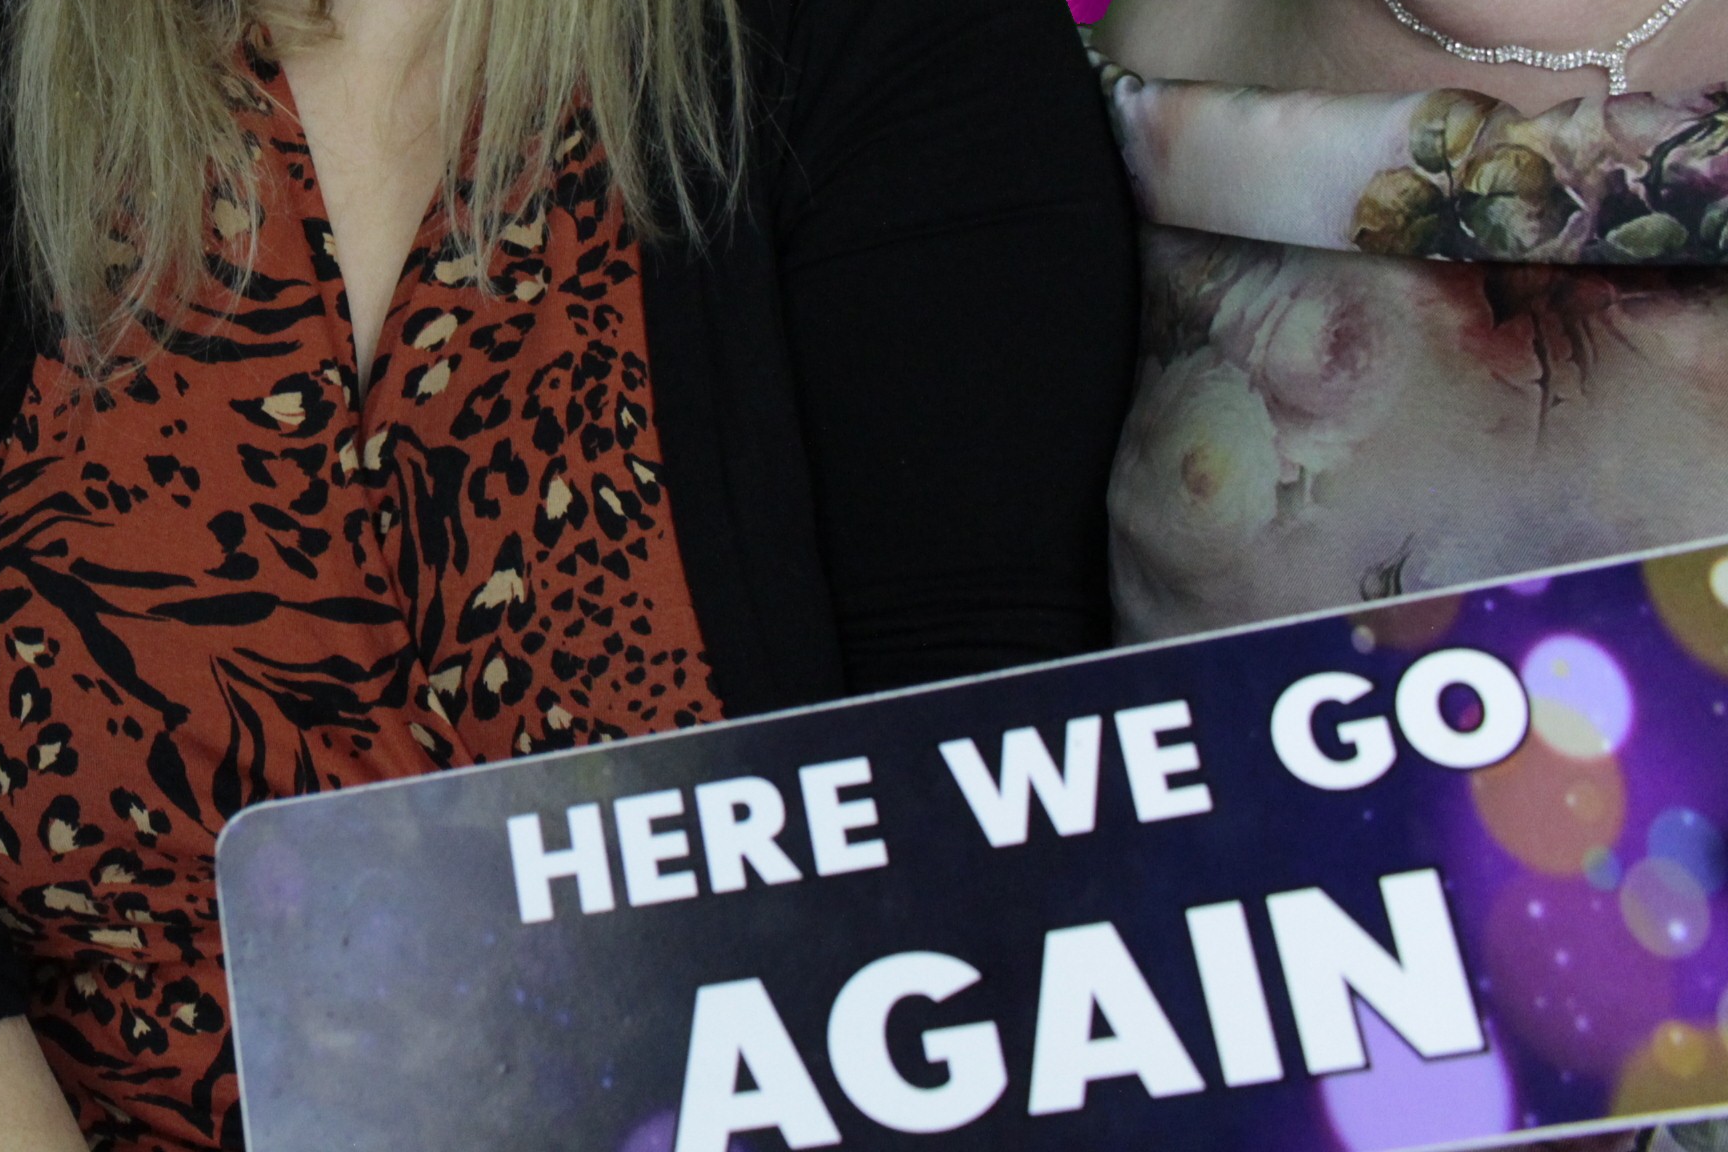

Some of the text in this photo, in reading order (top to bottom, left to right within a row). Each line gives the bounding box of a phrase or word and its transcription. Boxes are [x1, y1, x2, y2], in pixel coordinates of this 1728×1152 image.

[506, 648, 1528, 924] HERE WE GO
[674, 869, 1486, 1152] AGAIN
